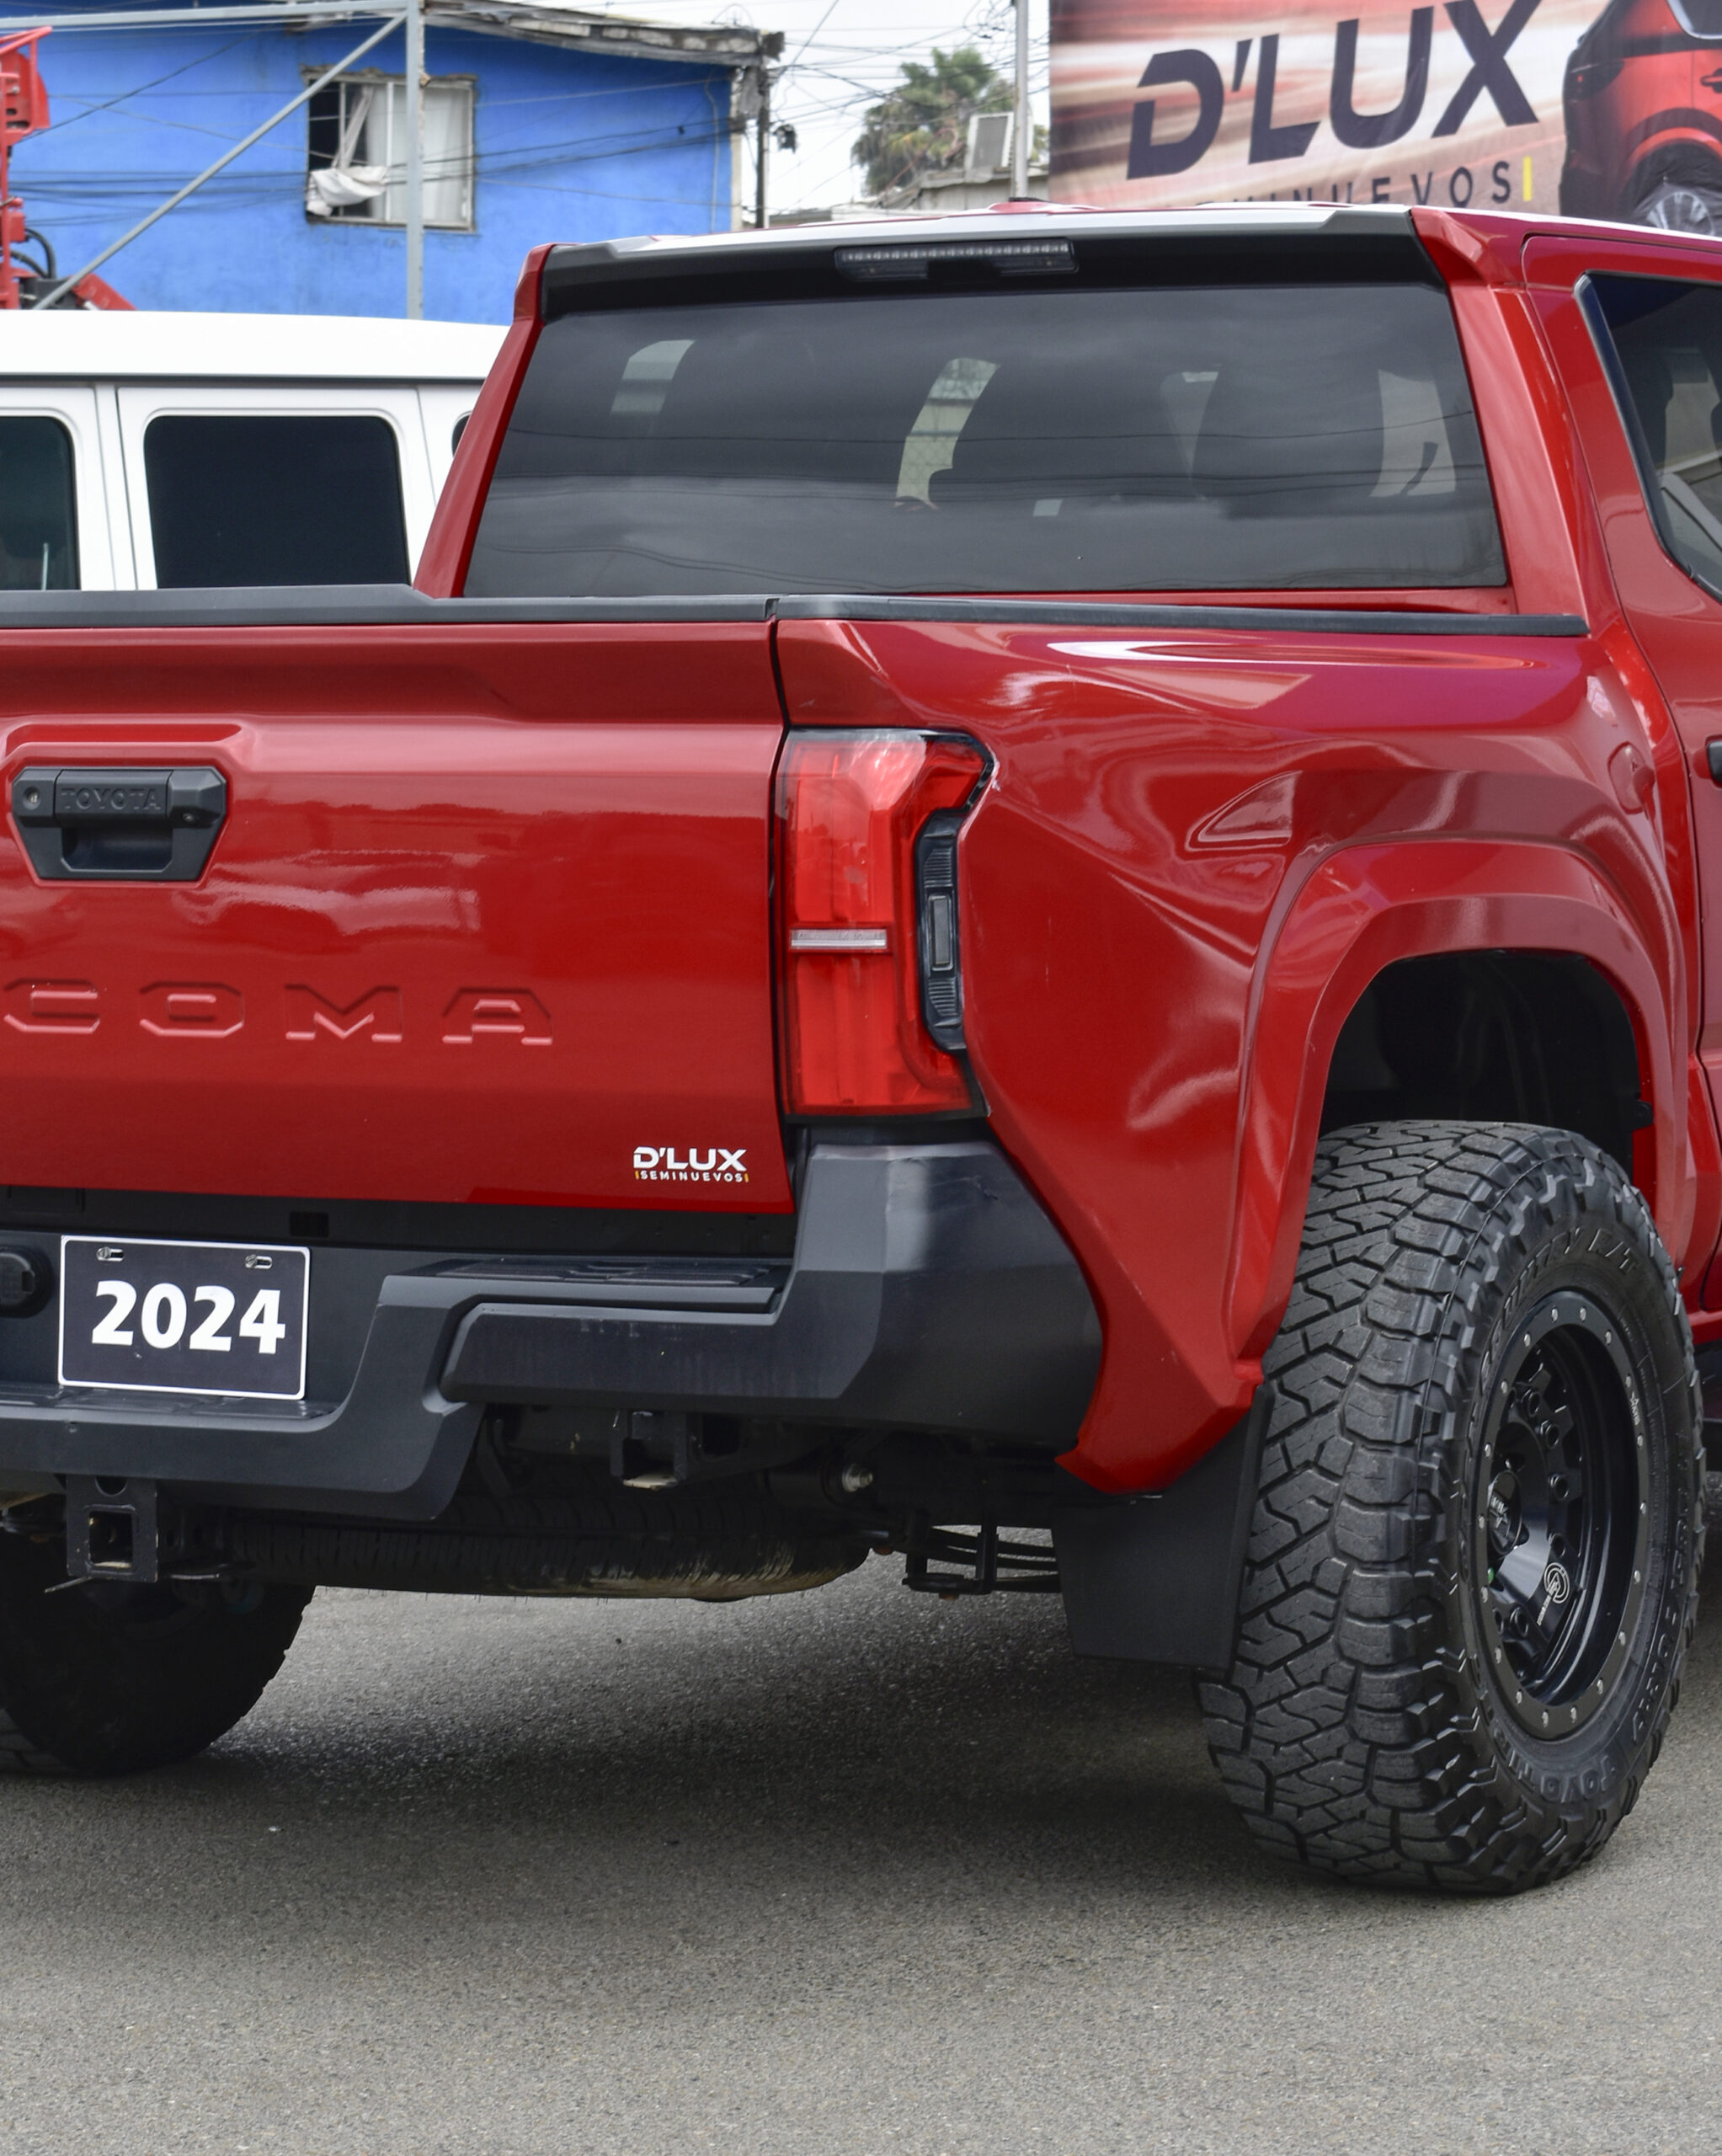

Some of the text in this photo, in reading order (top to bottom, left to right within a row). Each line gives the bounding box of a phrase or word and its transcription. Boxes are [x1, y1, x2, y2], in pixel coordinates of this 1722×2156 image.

[1126, 0, 1540, 179] D'LUX
[61, 787, 162, 810] TOYOTA
[633, 1146, 747, 1171] D'LUX
[640, 1170, 743, 1182] SEMINUEVOS
[92, 1280, 285, 1354] 2024
